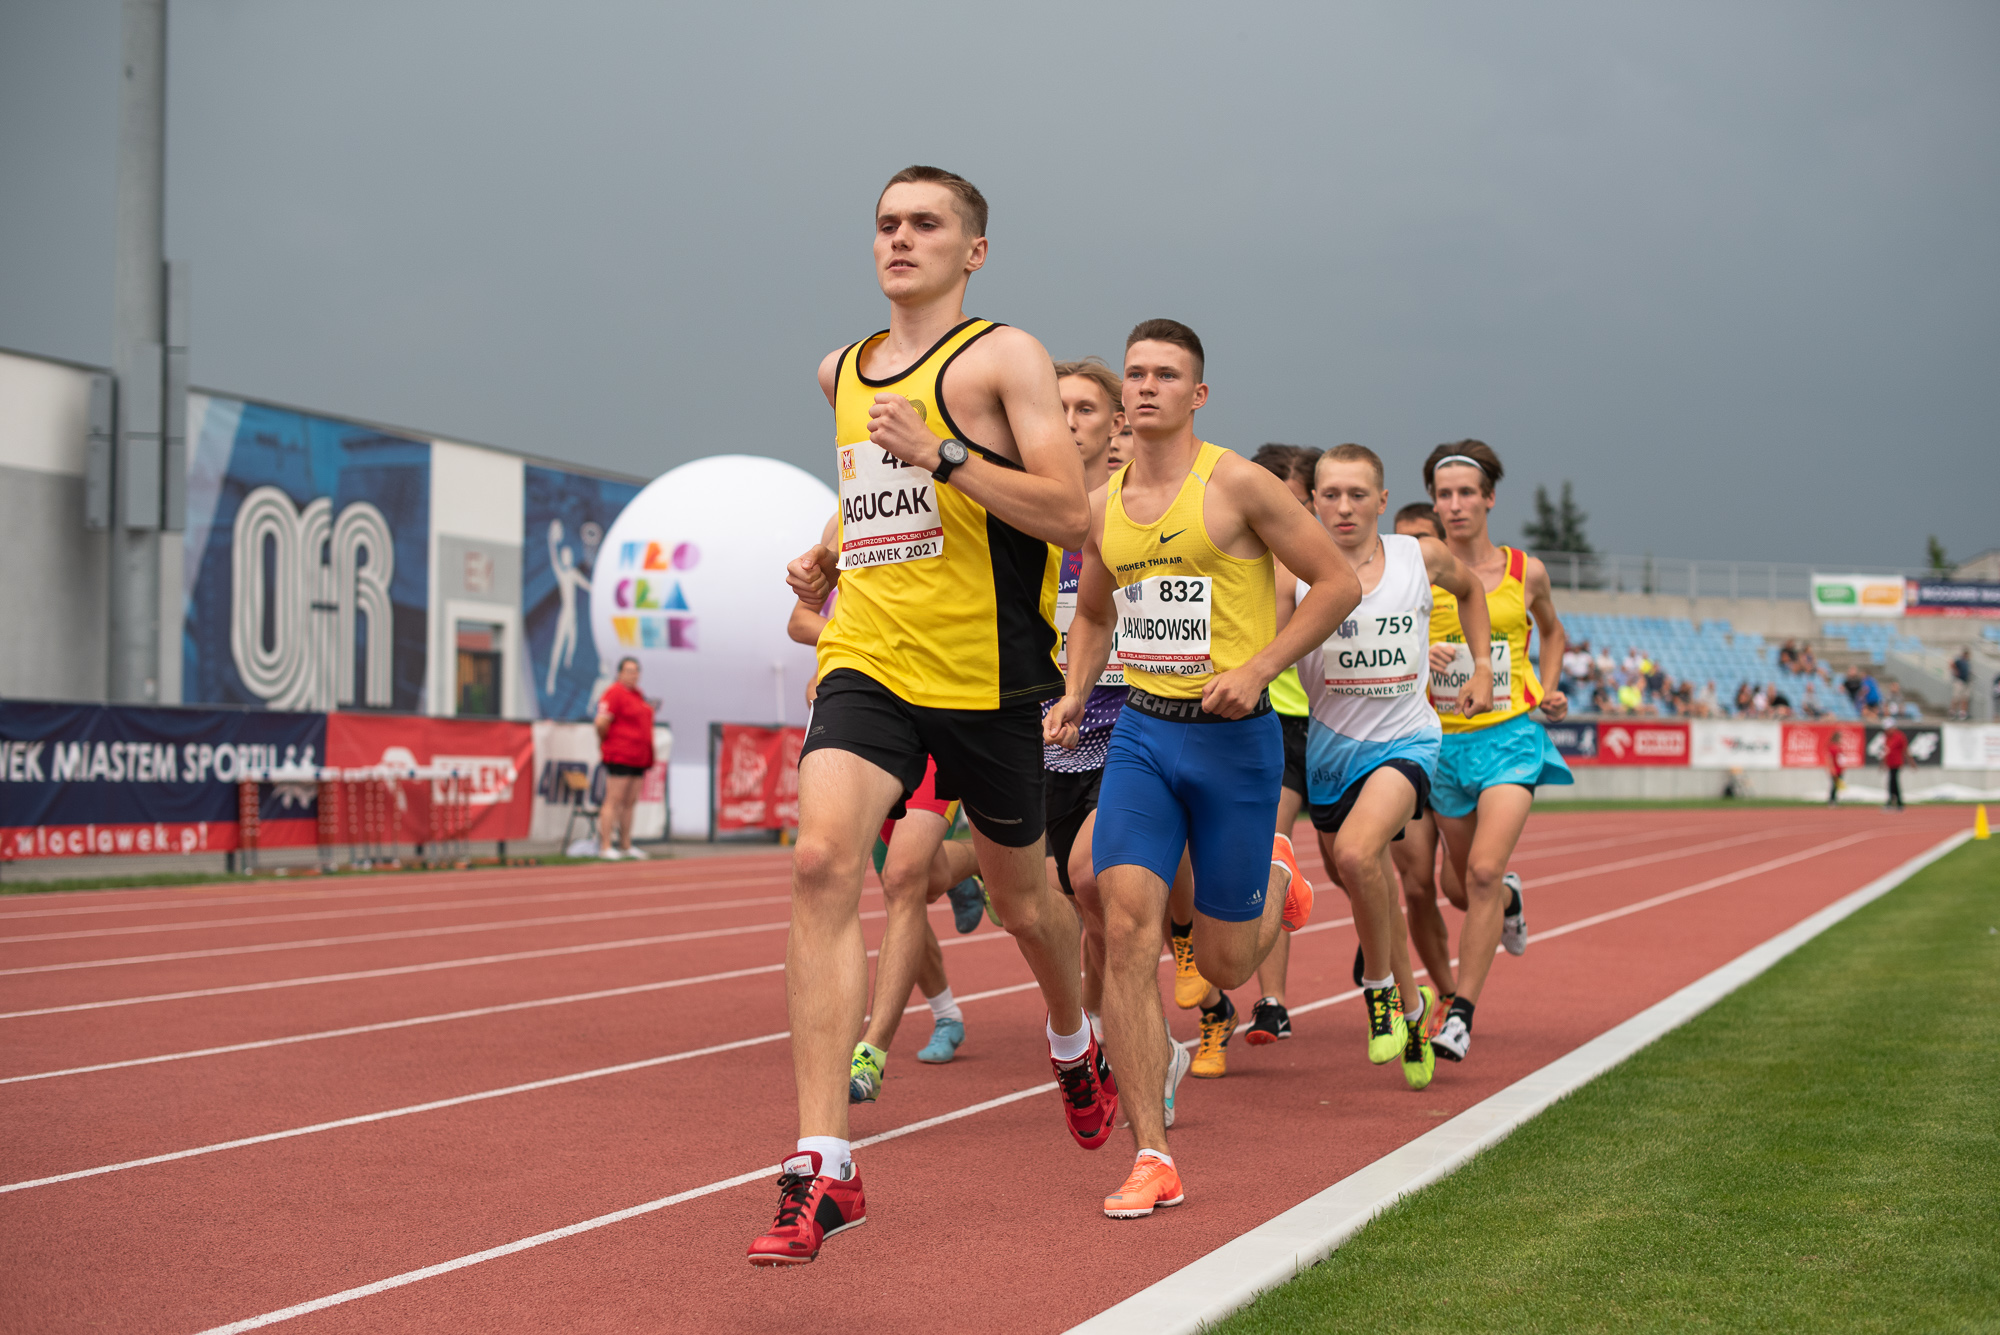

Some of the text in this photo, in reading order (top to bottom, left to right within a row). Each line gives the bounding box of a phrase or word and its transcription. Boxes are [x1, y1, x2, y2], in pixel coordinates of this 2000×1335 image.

[897, 532, 921, 542] POLSKI
[845, 542, 938, 567] WOCŁAWEK 2021
[1116, 556, 1183, 573] HIGHER THAN AIR
[1160, 580, 1204, 602] 832
[612, 615, 698, 651] WEK
[1122, 617, 1207, 641] JAKUBOWSKI
[1375, 616, 1413, 636] 759
[1338, 647, 1407, 668] GAJDA
[1106, 673, 1124, 683] 202
[1180, 663, 1207, 675] 2021
[1331, 683, 1413, 696] WŁOCŁAWEK 2021
[1127, 686, 1201, 718] TECHFIT
[0, 822, 208, 857] .wloclawek.pl
